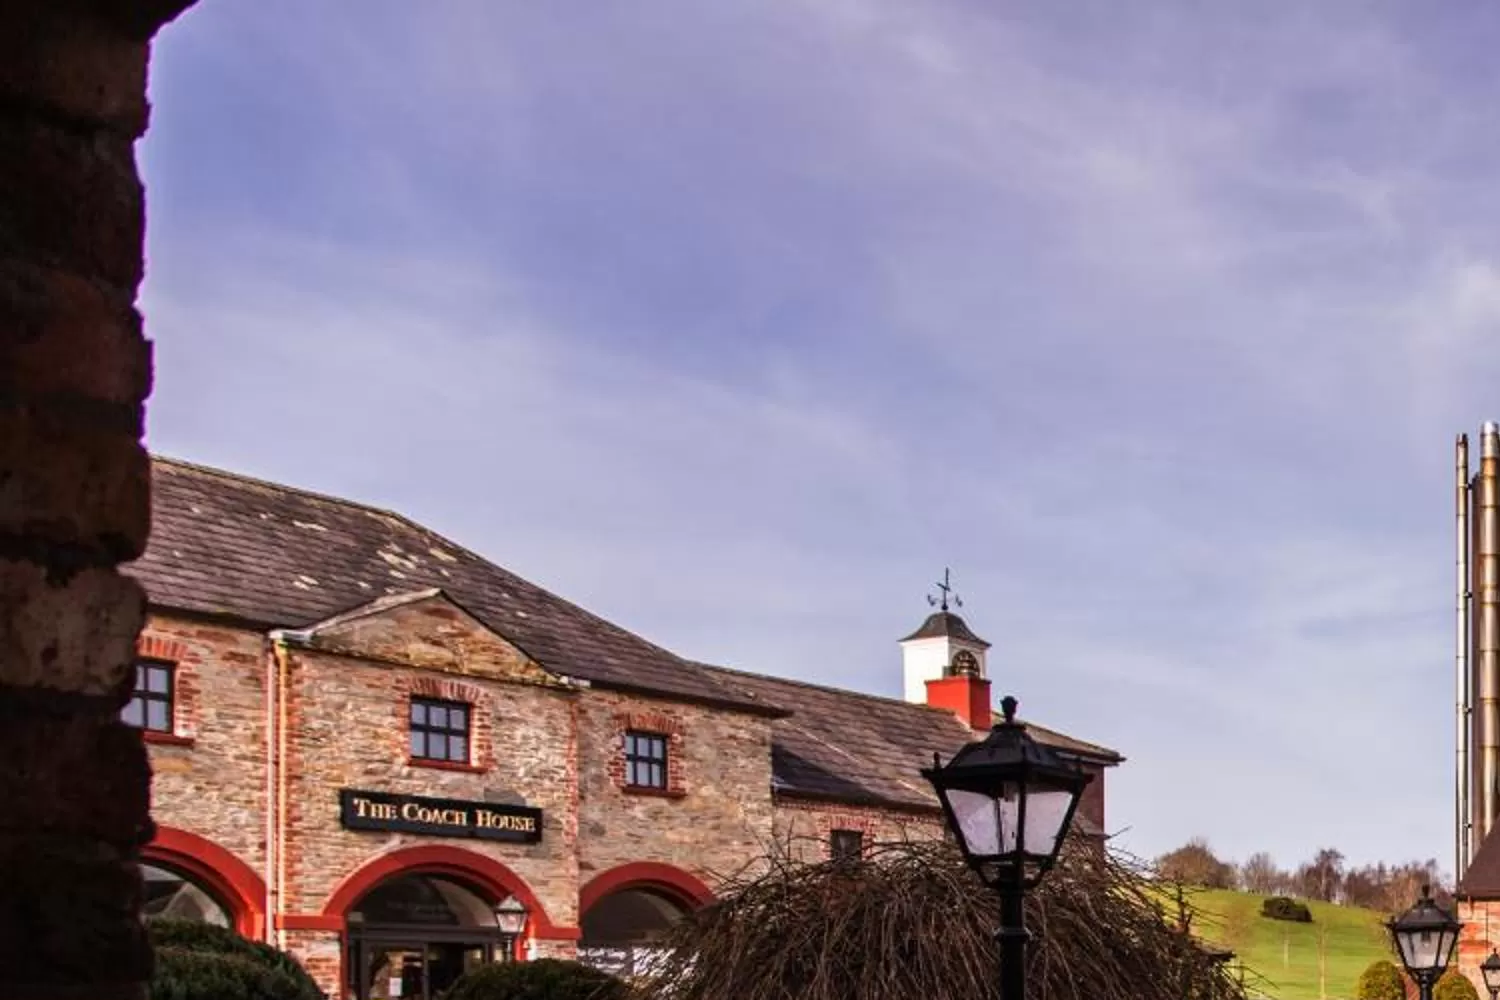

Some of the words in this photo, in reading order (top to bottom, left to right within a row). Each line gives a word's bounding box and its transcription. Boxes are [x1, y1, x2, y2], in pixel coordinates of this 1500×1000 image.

[353, 798, 398, 820] THE
[401, 803, 468, 827] COACH
[475, 809, 536, 832] HOUSE
